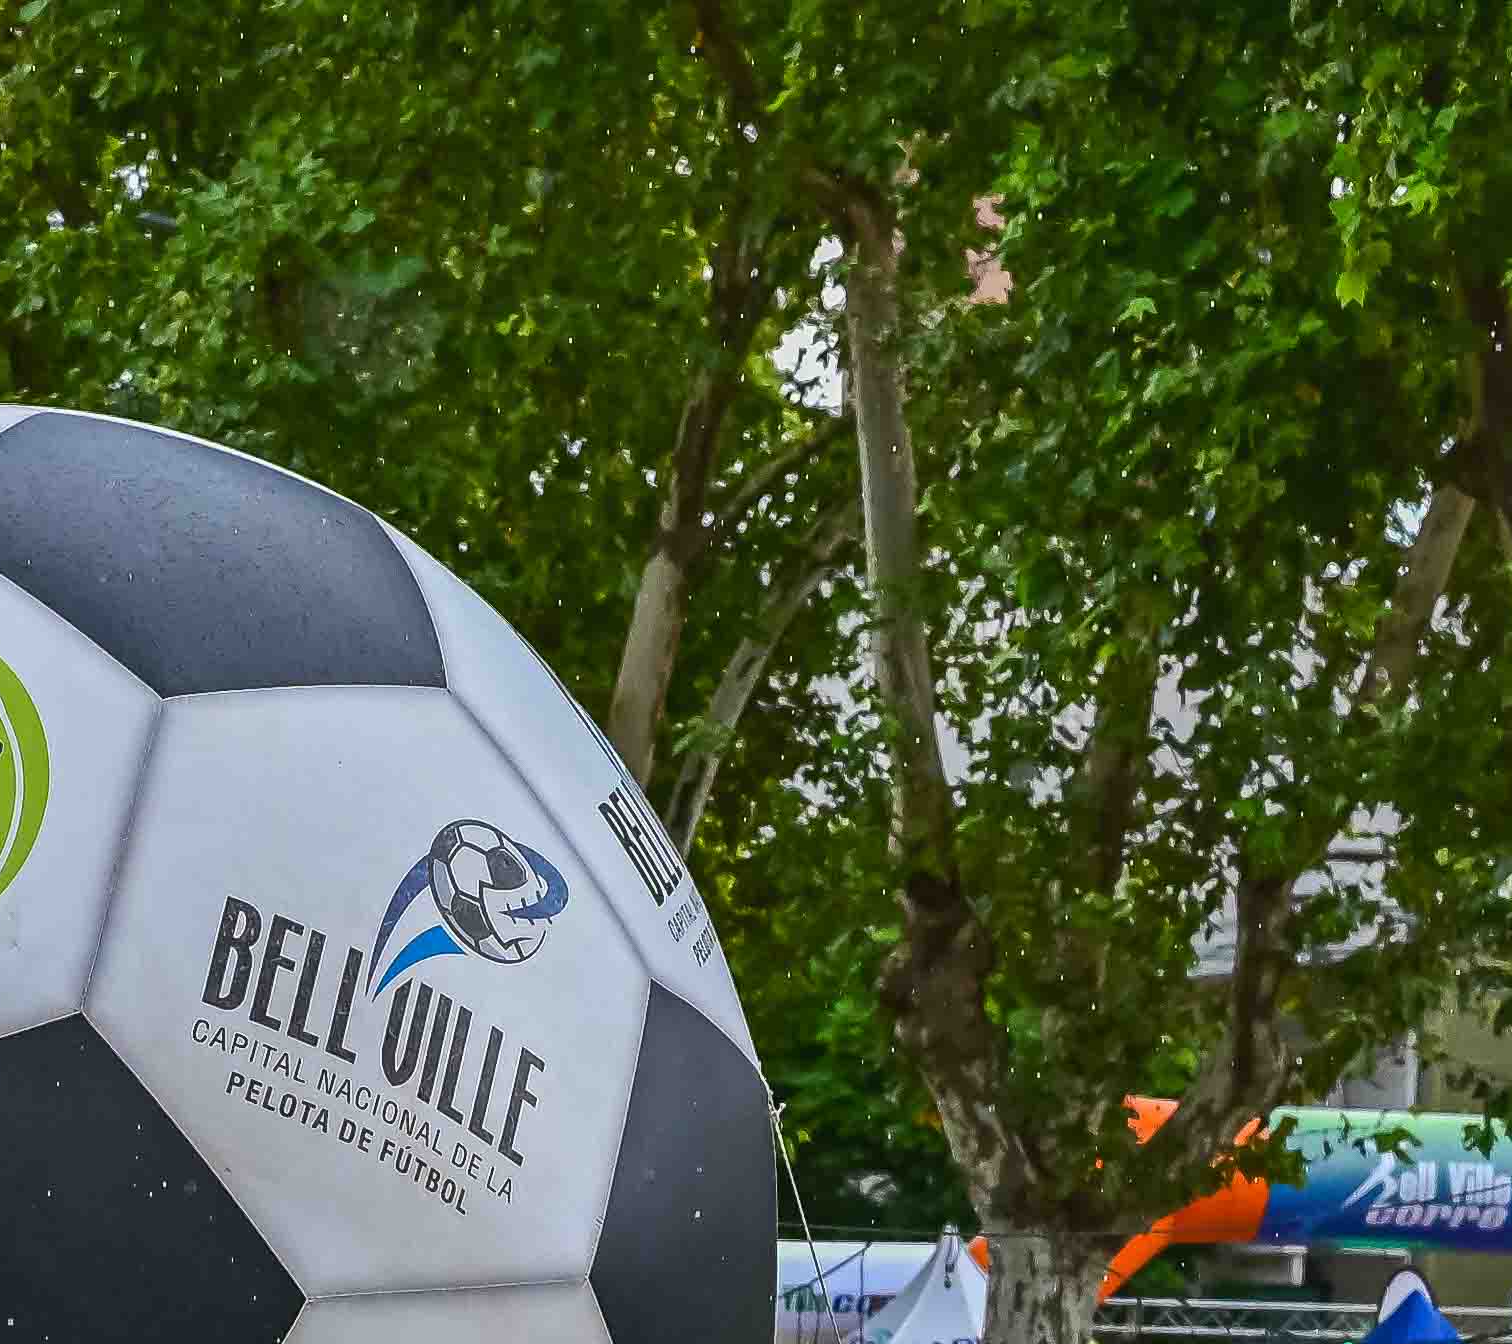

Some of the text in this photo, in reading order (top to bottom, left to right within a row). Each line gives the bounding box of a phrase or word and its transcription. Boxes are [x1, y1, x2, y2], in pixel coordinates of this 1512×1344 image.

[201, 895, 365, 1064] BELL
[190, 1018, 514, 1206] CAPITAL NACIONAL DE LA
[224, 1071, 469, 1216] PELOTA DE FÚTBOL
